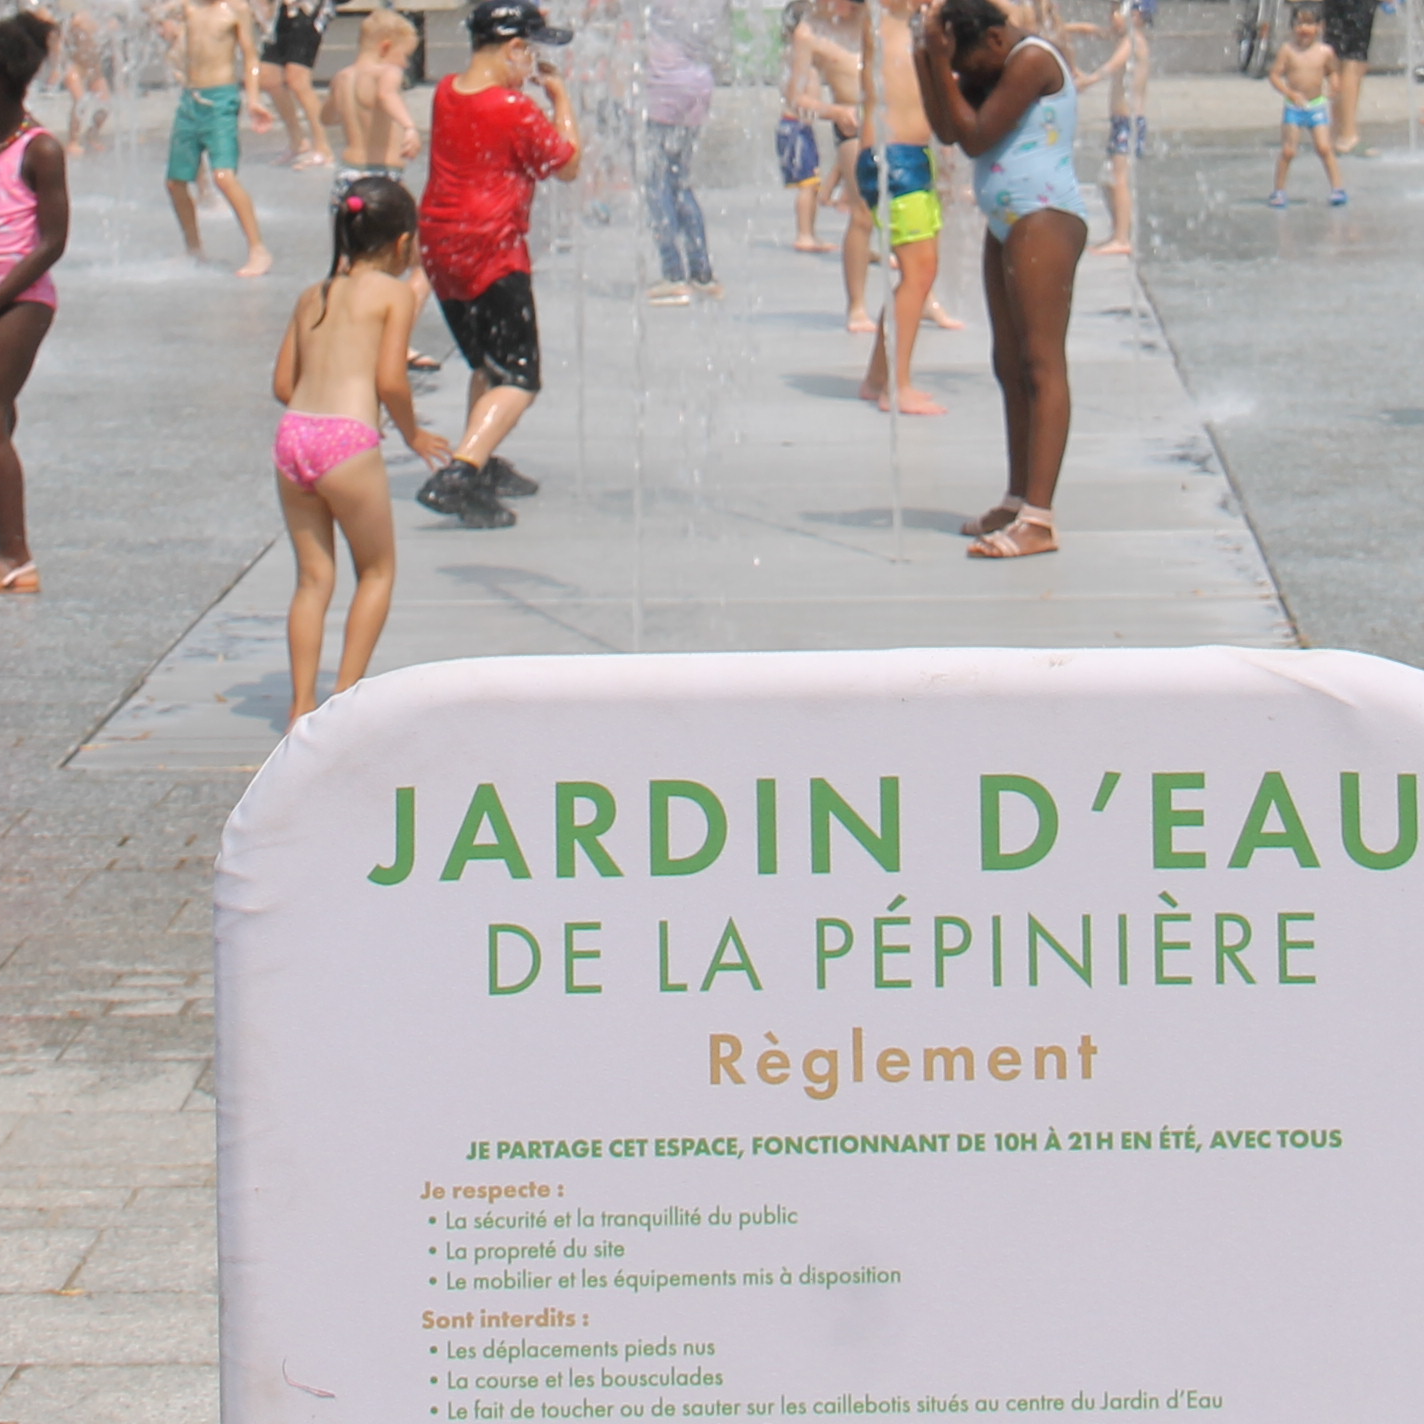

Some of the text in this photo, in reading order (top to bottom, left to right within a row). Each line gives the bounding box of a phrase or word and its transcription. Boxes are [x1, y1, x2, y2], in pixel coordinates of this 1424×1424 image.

[366, 775, 902, 887] JARDIN
[487, 890, 1317, 997] DE LA PÉPINIÈRE
[709, 1026, 1099, 1101] Règlement
[465, 1123, 1344, 1161] JE PARTAGE CET ESPACE, FONCTIONNANT DE 10H À 21H EN ÉTÉ, AVEC TOUS
[419, 1180, 446, 1201] Je
[452, 1180, 552, 1205] respecte
[445, 1203, 799, 1233] La sécurité et la tranquillité du public
[446, 1237, 626, 1266] La propreté du site
[446, 1263, 902, 1294] Le mobilier et les équipements mis à disposition
[421, 1309, 475, 1330] Sont
[479, 1306, 577, 1329] interdits
[447, 1335, 716, 1365] Les déplacements pieds nus
[447, 1365, 724, 1391] La course et les bousculades
[447, 1401, 469, 1421] Le
[473, 1398, 505, 1421] fait
[509, 1398, 536, 1420] de
[540, 1397, 615, 1420] toucher
[619, 1404, 645, 1419] ou
[650, 1396, 677, 1418] de
[682, 1399, 742, 1418] sauter
[746, 1401, 776, 1417] sur
[780, 1394, 808, 1416] les
[812, 1392, 911, 1415] caillebotis
[916, 1393, 970, 1414] situés
[974, 1398, 1000, 1413] au
[1005, 1394, 1066, 1413] centre
[1070, 1389, 1096, 1412] du
[1099, 1388, 1160, 1411] Jardin
